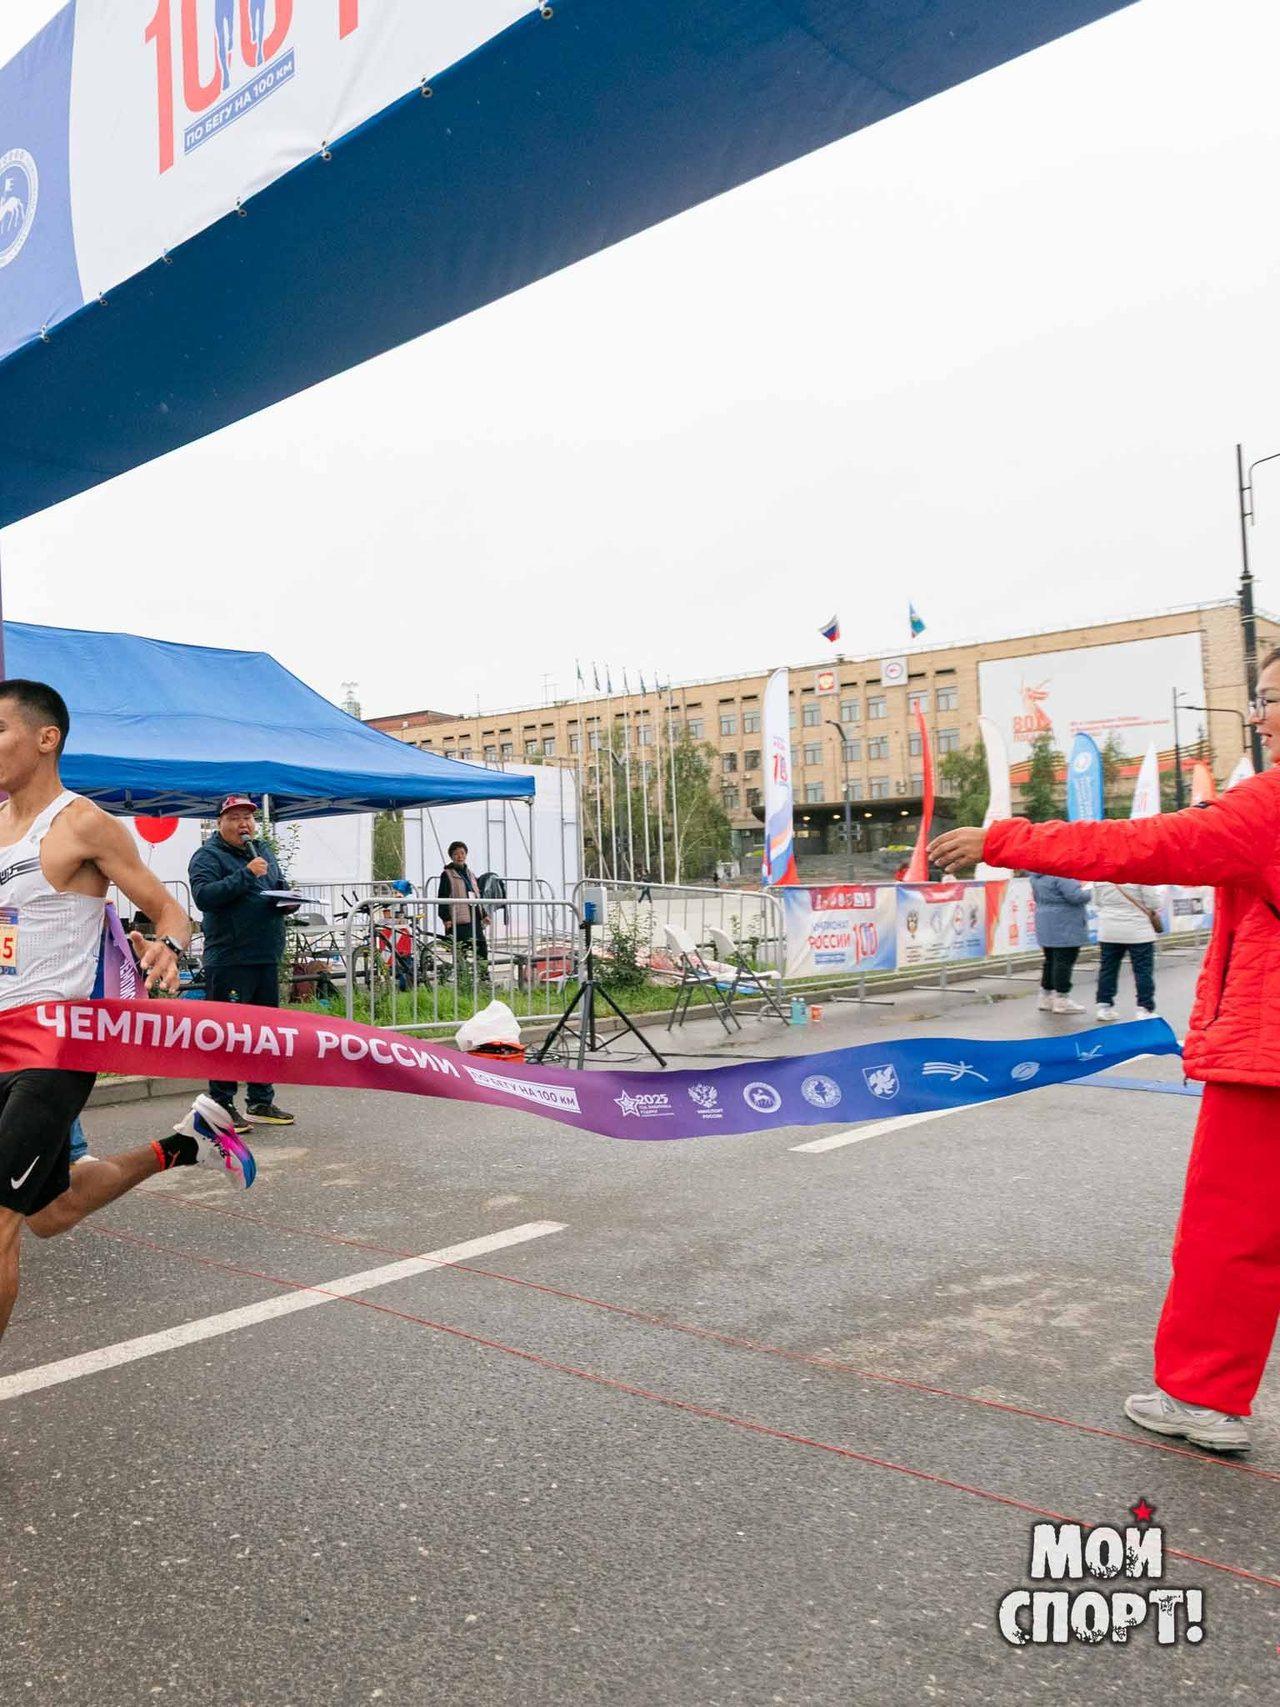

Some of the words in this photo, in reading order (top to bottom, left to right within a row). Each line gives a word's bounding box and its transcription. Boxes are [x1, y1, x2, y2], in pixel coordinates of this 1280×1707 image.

[186, 127, 204, 147] ПО
[205, 103, 232, 133] БЕГУ
[234, 90, 252, 113] НА
[253, 73, 274, 97] 100
[808, 933, 851, 949] РОССИИ
[36, 1005, 298, 1057] ЧЕМПИОНАТ
[316, 1030, 461, 1078] РОССИИ
[520, 1084, 536, 1096] НА
[538, 1090, 558, 1103] 100
[636, 1094, 669, 1105] 2025
